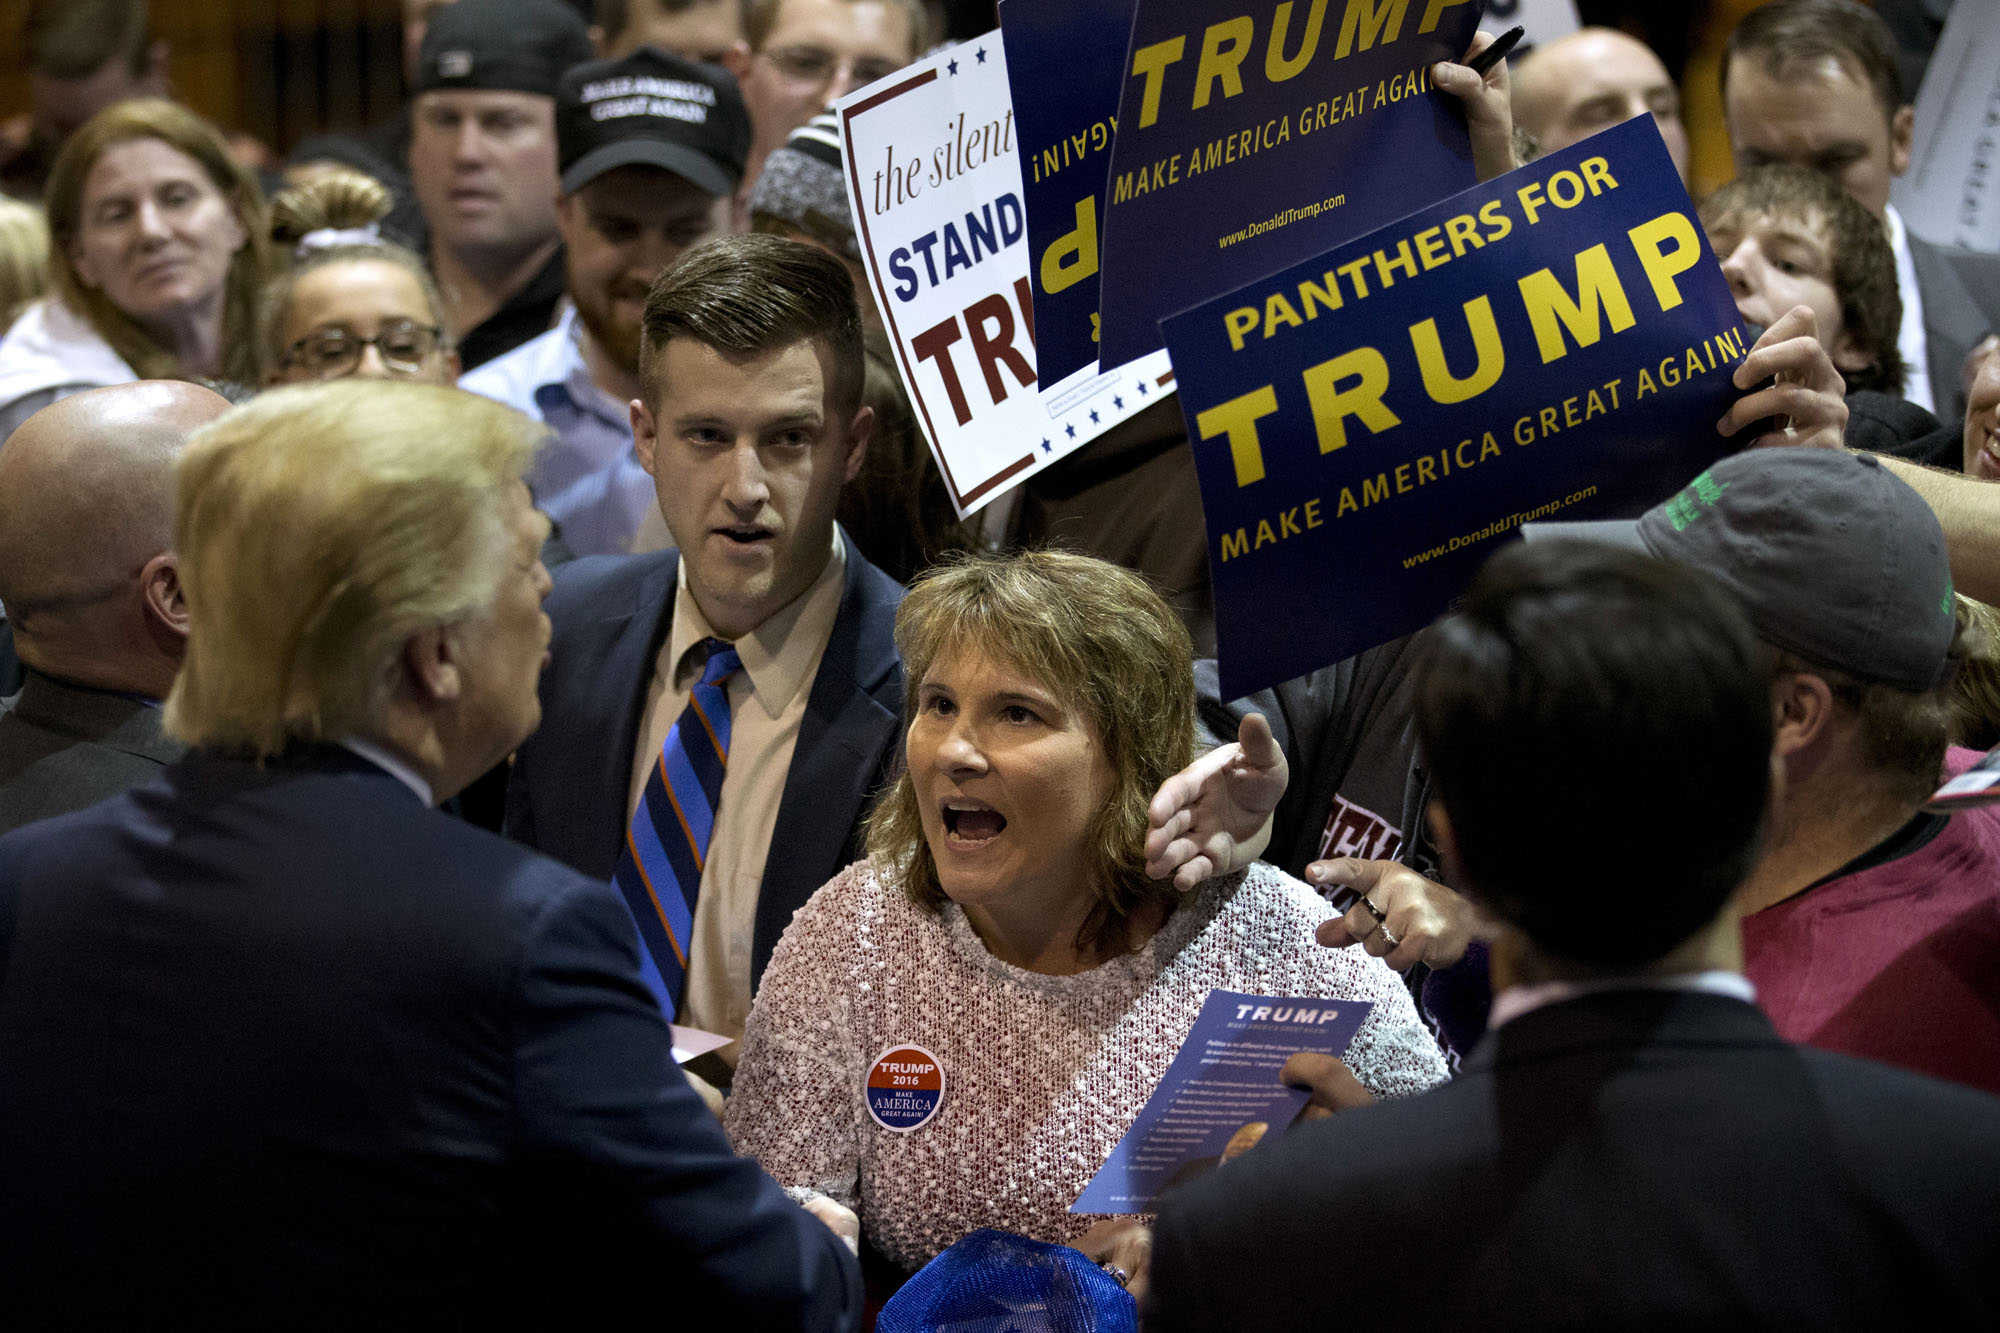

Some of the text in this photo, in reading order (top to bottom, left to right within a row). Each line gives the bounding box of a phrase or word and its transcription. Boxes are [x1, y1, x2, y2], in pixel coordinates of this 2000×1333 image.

[873, 108, 1014, 216] the silent
[1114, 155, 1182, 204] MAKE
[1187, 116, 1290, 178] AMERICA
[1299, 87, 1369, 136] GREAT
[889, 191, 1024, 302] STAND
[1219, 193, 1345, 249] www.DonaldJTrump.com
[1224, 156, 1619, 351] PANTHERS FOR
[1197, 212, 1701, 488] TRUMP
[1221, 326, 1748, 563] MAKE AMERICA GREAT AGAIN!
[1402, 485, 1598, 569] www.DonaldJTrump.com
[1236, 1004, 1339, 1024] TRUMP
[874, 1097, 931, 1110] AMERICA
[880, 1062, 934, 1074] TRUMP
[892, 1075, 919, 1085] 2016
